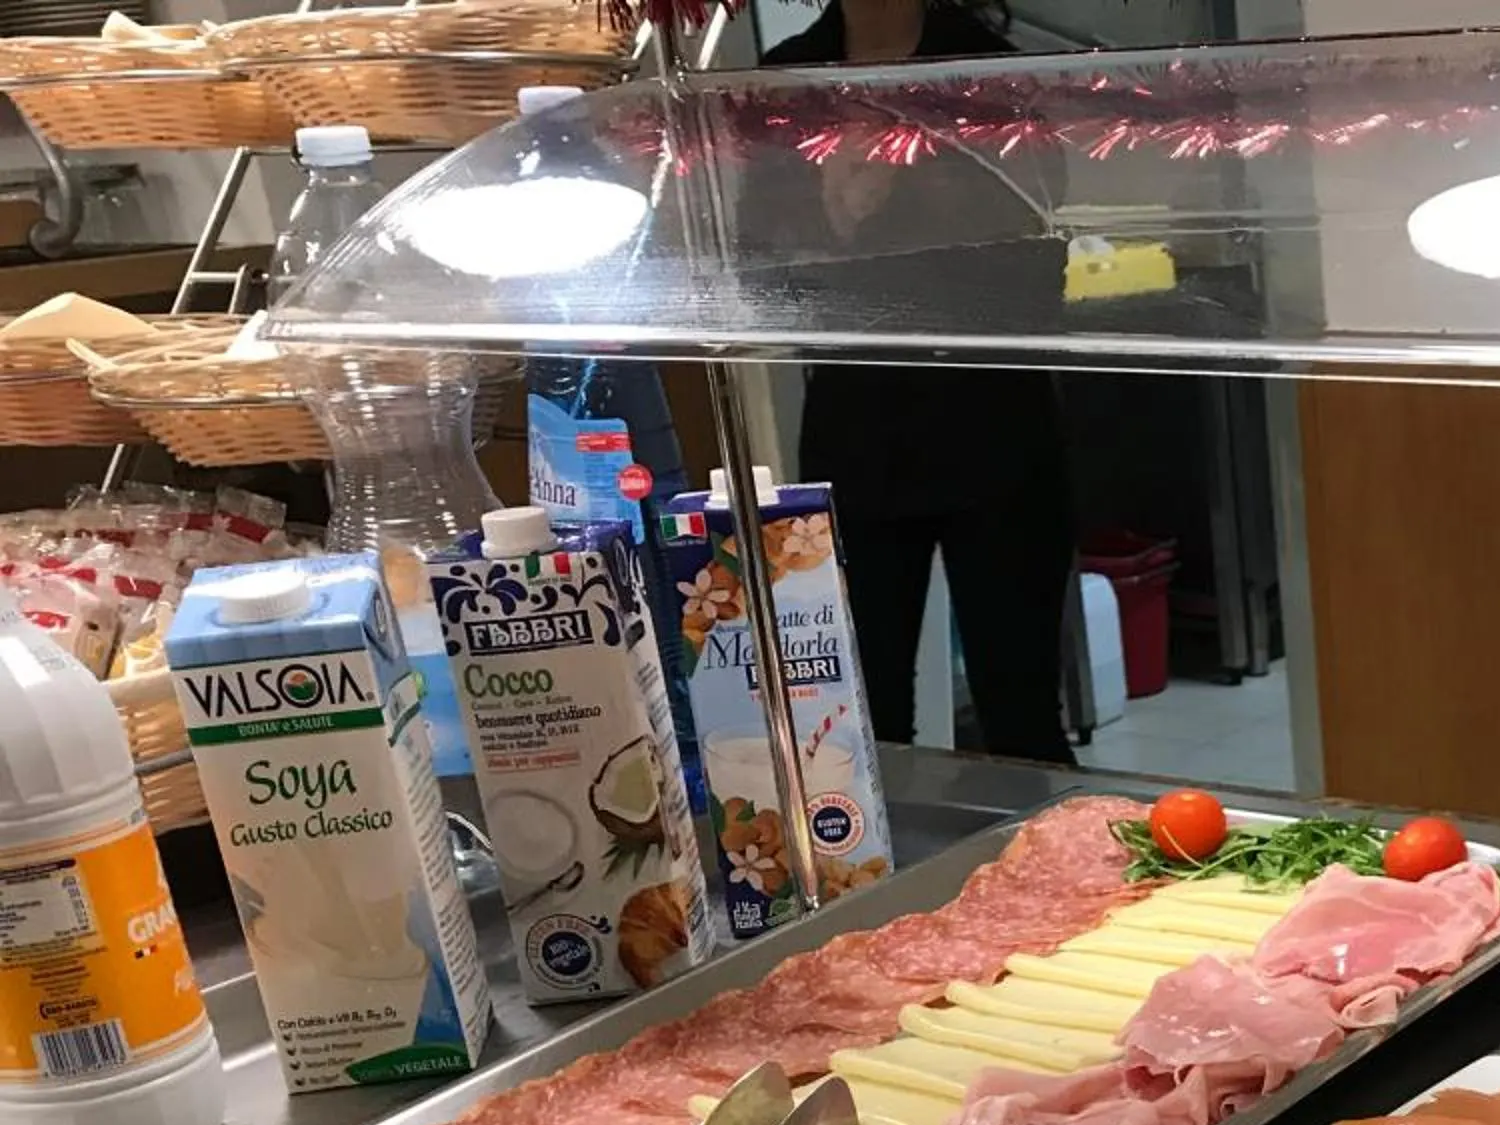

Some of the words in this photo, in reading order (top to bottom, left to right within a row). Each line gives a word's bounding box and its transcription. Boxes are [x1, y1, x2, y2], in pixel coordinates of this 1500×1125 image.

[471, 614, 587, 646] FABBRI
[814, 604, 834, 625] di
[704, 631, 839, 670] Maorla
[464, 664, 554, 698] Cocco
[750, 658, 838, 683] FBBRI
[184, 661, 366, 718] VALSOIA
[292, 715, 334, 731] SALUTE
[245, 760, 357, 809] Soya
[231, 820, 297, 847] Gusto
[304, 808, 393, 839] Classico
[128, 903, 178, 943] GRA
[393, 1054, 463, 1074] VEGETALE
